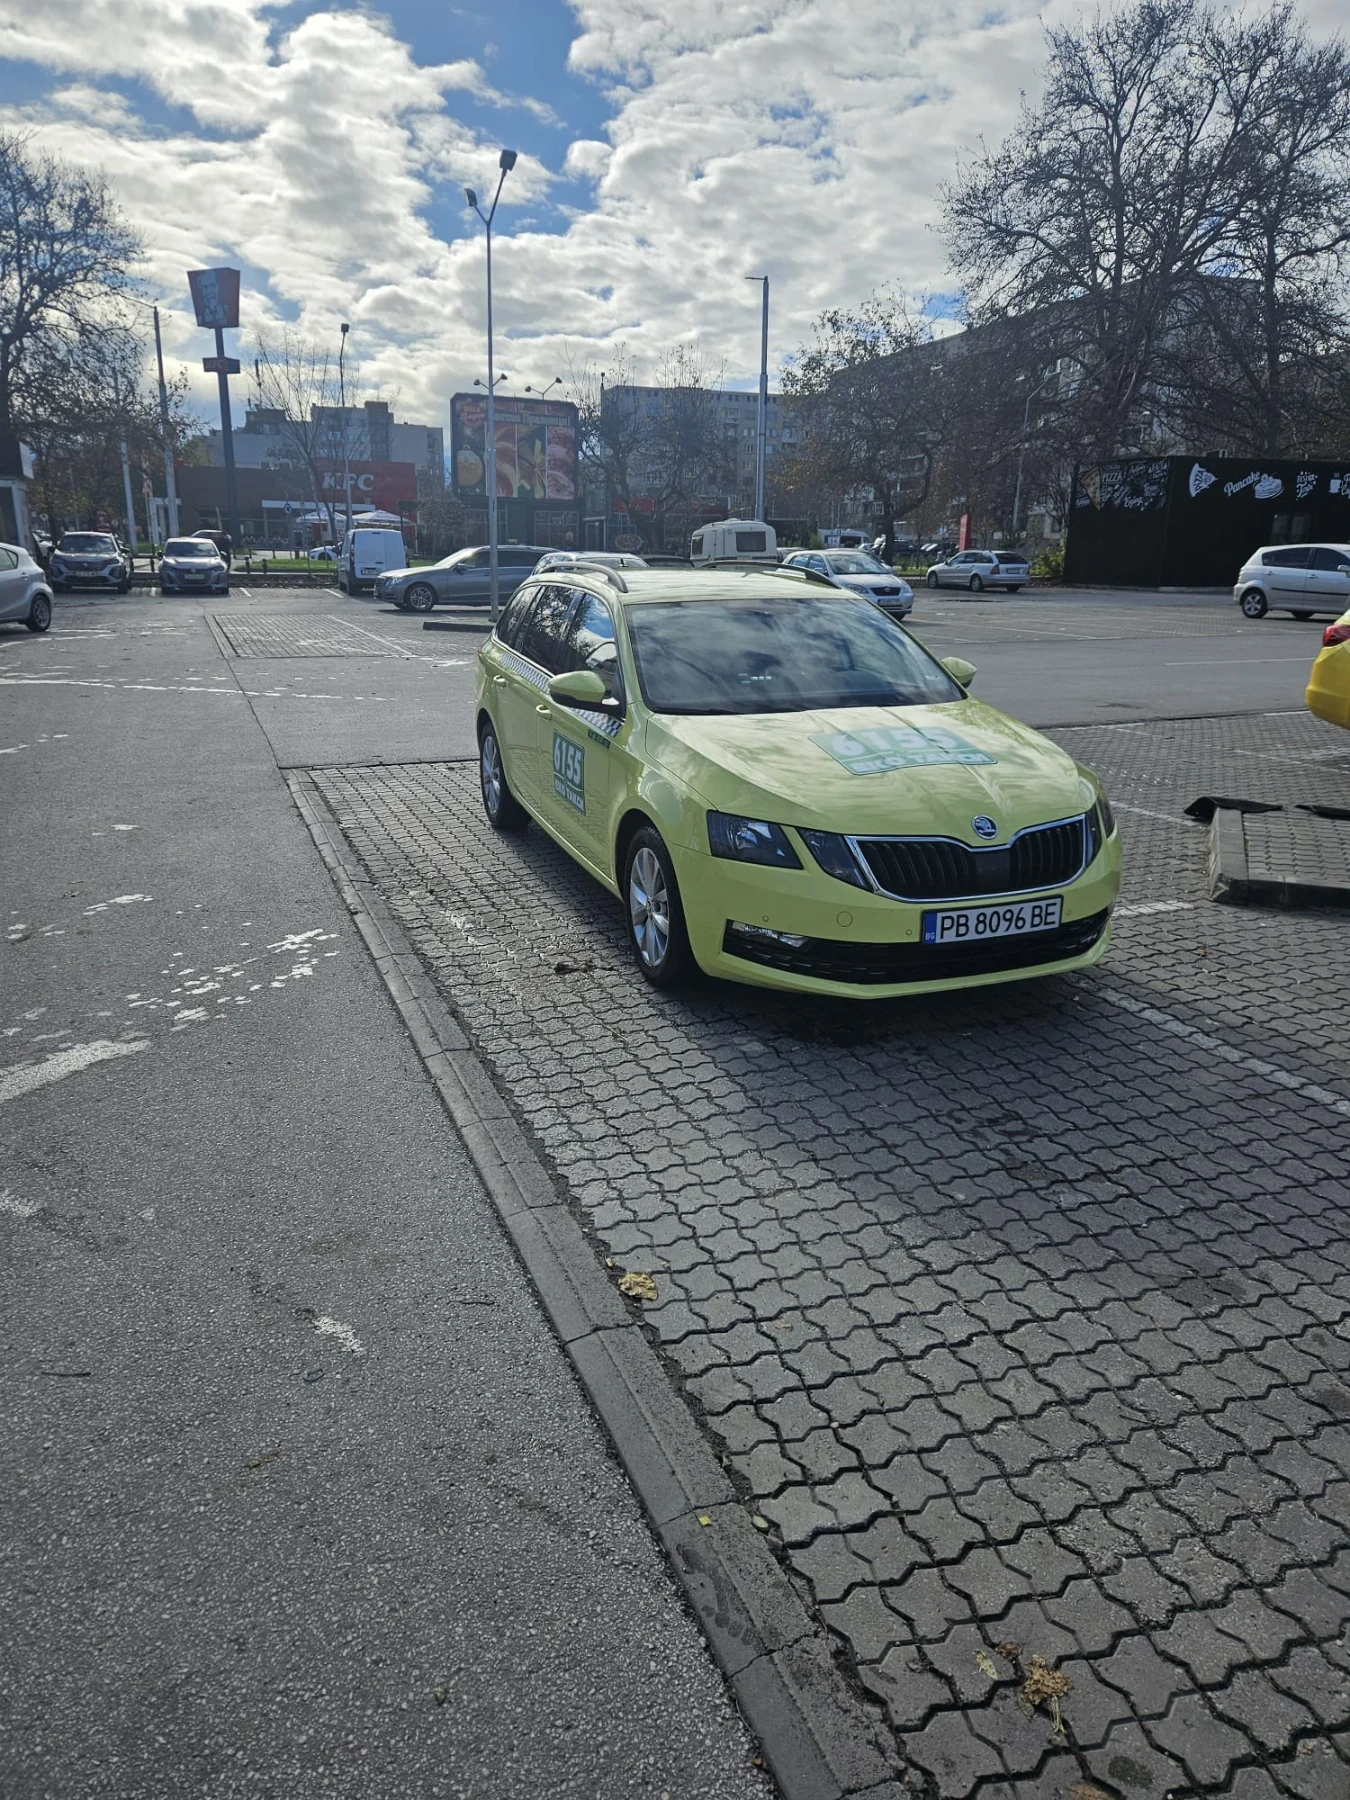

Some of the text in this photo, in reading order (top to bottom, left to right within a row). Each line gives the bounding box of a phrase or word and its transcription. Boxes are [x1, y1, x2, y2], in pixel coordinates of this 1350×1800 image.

[322, 472, 374, 491] KFC
[1102, 472, 1122, 482] PIZZA
[1224, 471, 1260, 497] Pancake
[832, 728, 958, 757] 6155
[554, 738, 582, 786] 6155
[940, 914, 970, 939] PB
[974, 907, 1027, 935] 8096
[1030, 902, 1058, 928] BE
